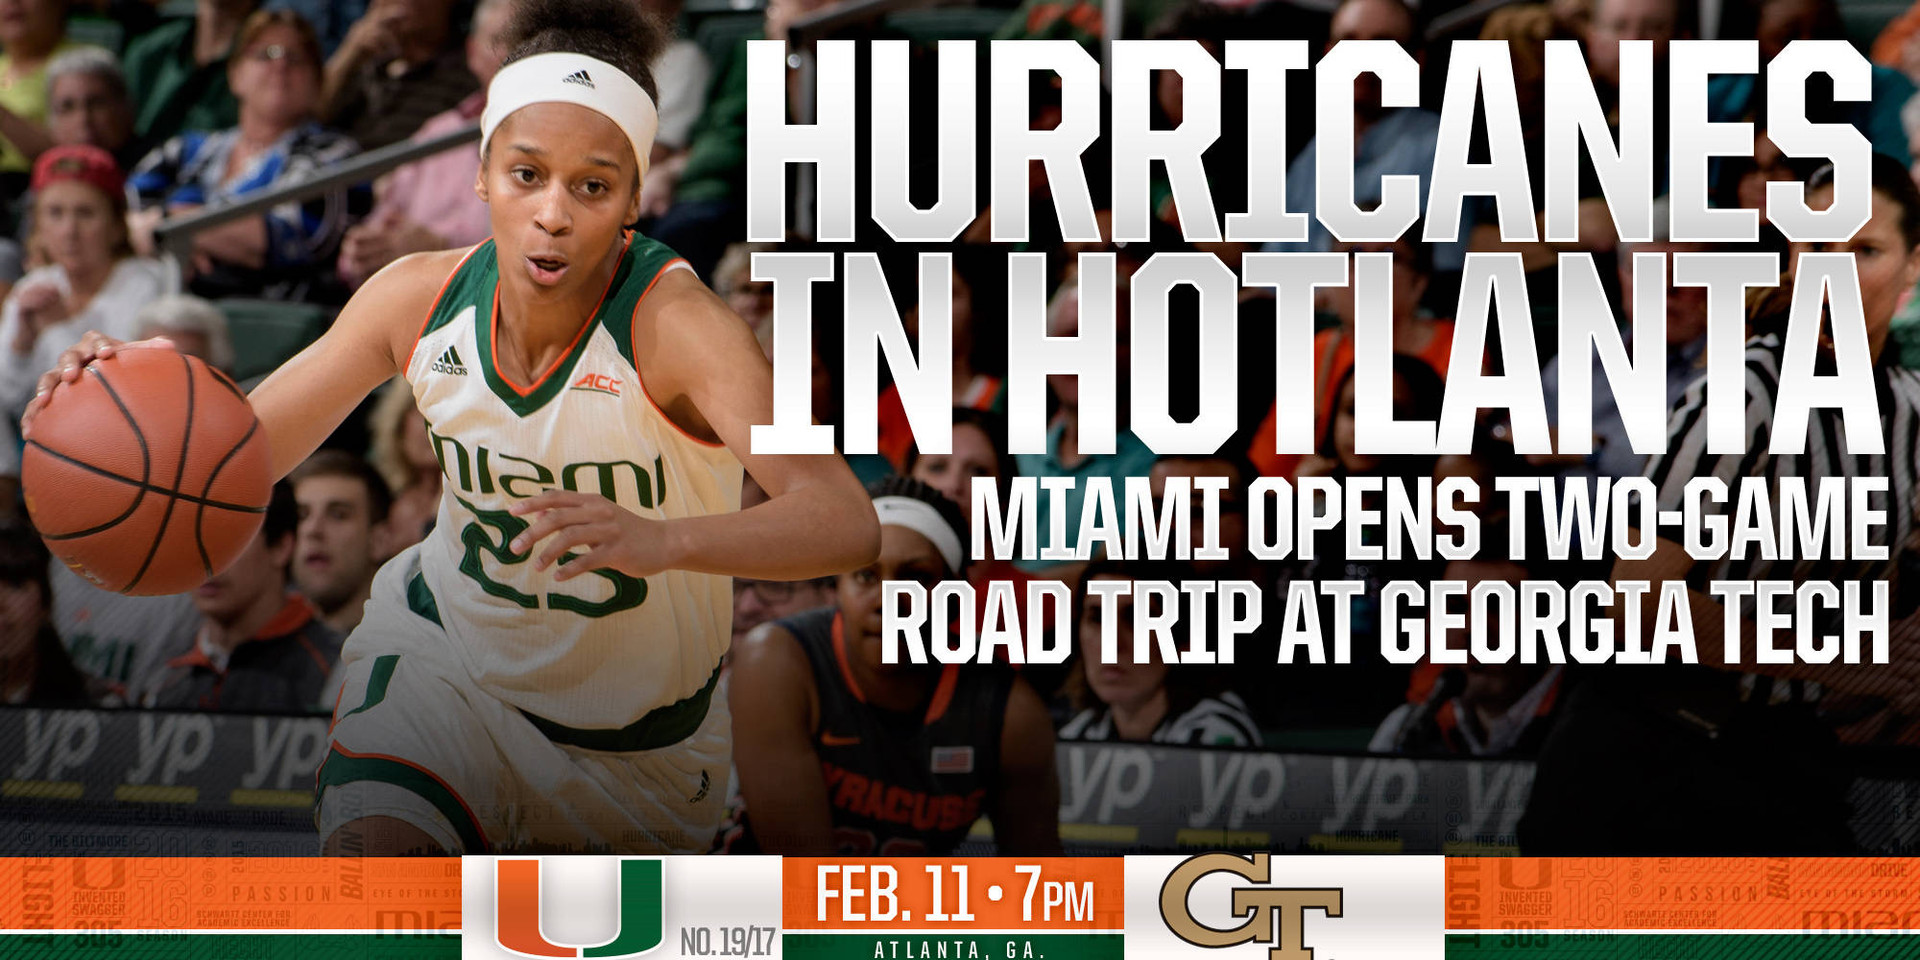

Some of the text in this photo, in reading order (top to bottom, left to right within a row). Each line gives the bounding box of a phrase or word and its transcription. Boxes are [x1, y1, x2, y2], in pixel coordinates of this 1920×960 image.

[432, 359, 468, 376] adidas
[575, 373, 623, 394] ACC
[13, 709, 100, 781] yp
[125, 712, 214, 785] yp
[241, 716, 331, 789] yp
[821, 762, 988, 832] YRACUSE
[1059, 748, 1153, 823] yp
[1190, 752, 1286, 829] yp
[1318, 757, 1418, 835] yp
